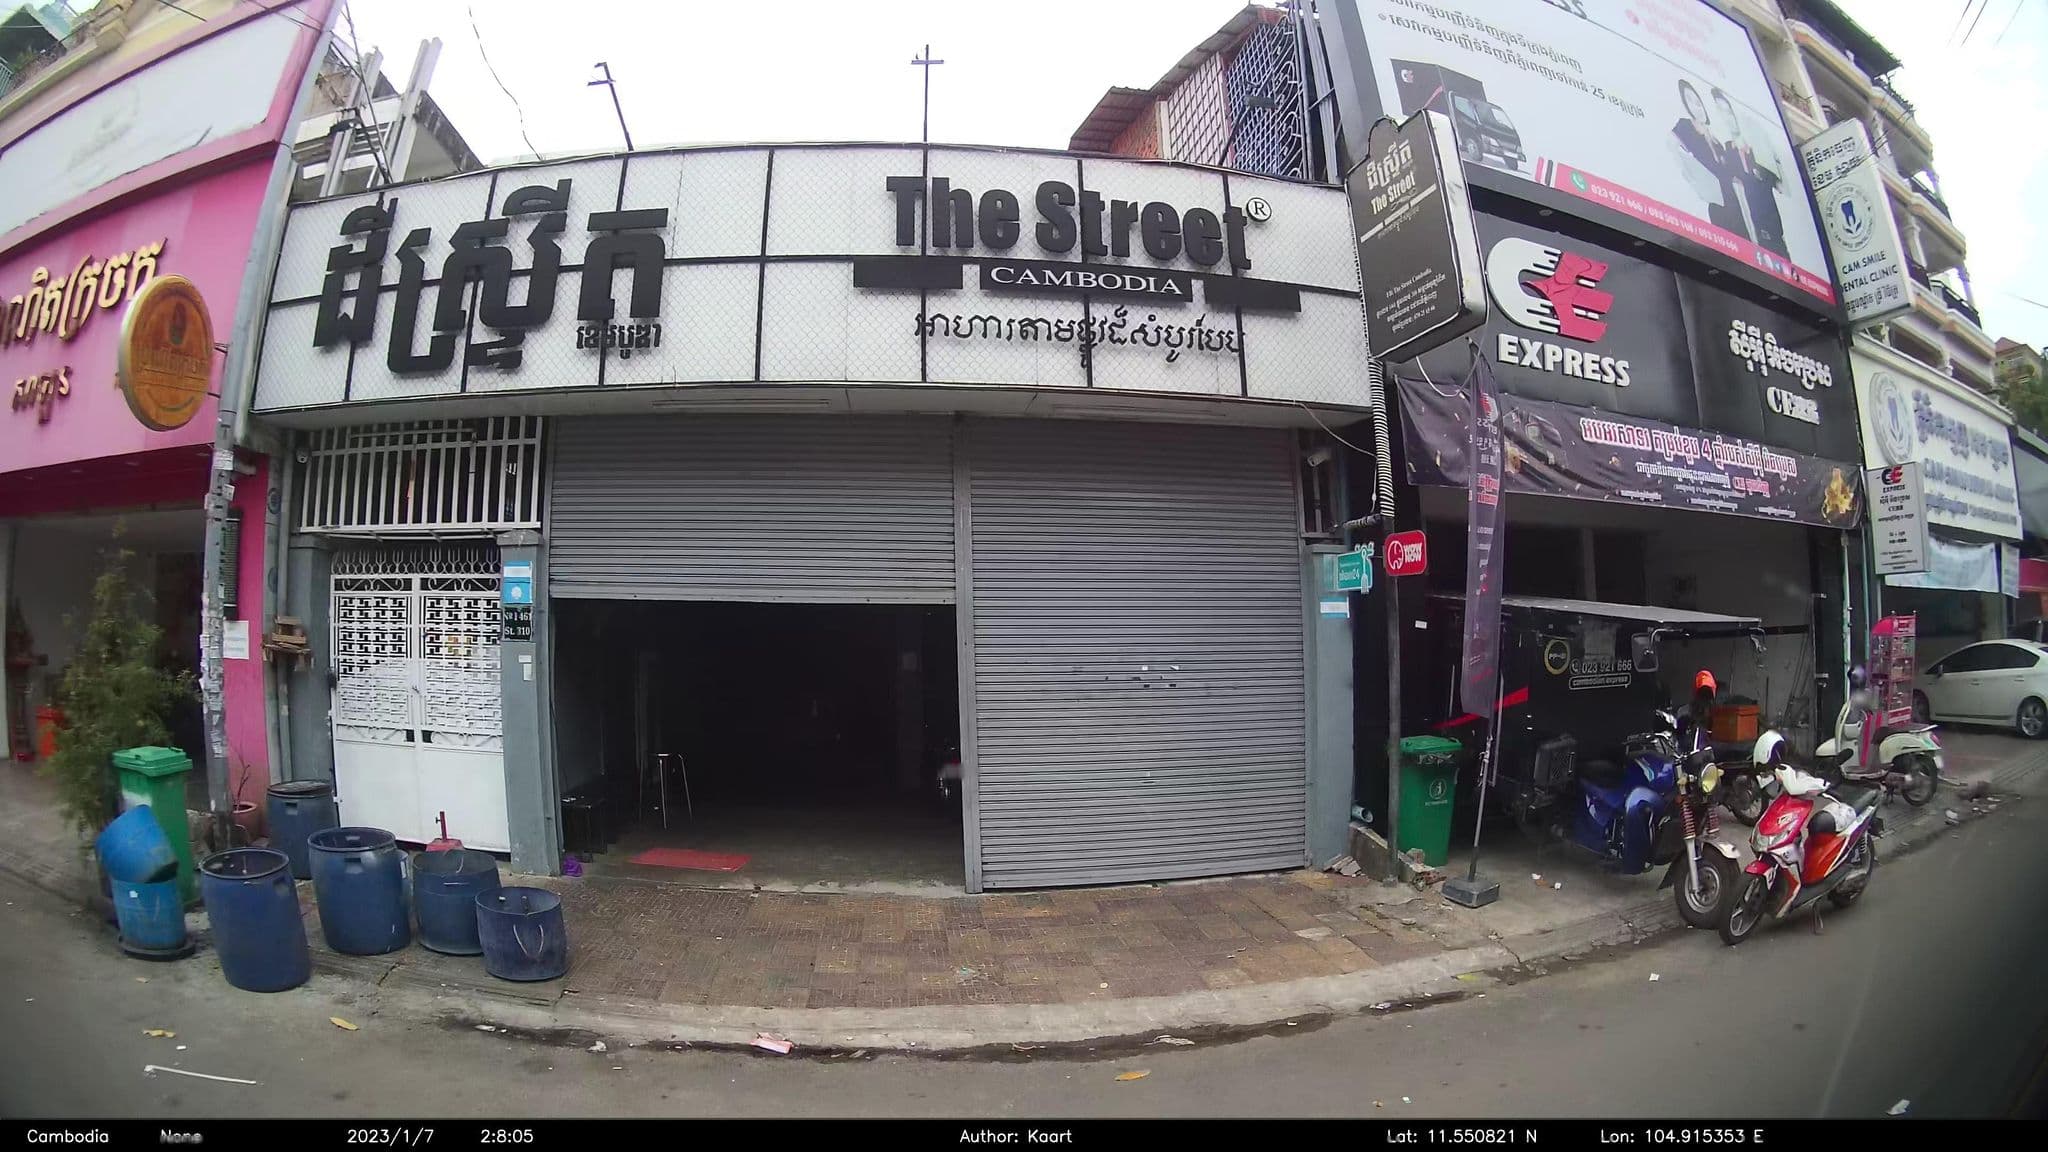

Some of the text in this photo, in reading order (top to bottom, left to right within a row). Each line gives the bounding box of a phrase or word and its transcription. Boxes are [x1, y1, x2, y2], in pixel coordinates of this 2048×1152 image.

[1590, 85, 1605, 99] 25
[1371, 193, 1388, 215] The
[1387, 171, 1417, 204] Street
[886, 176, 1020, 250] The
[1035, 181, 1252, 270] Street
[1841, 249, 1887, 275] CAM SMILE
[1869, 263, 1899, 285] CLINIC
[990, 266, 1183, 297] CAMBODIA
[1497, 333, 1630, 388] EXPRESS
[1701, 438, 1712, 461] 4
[1581, 658, 1632, 674] 023 921 666
